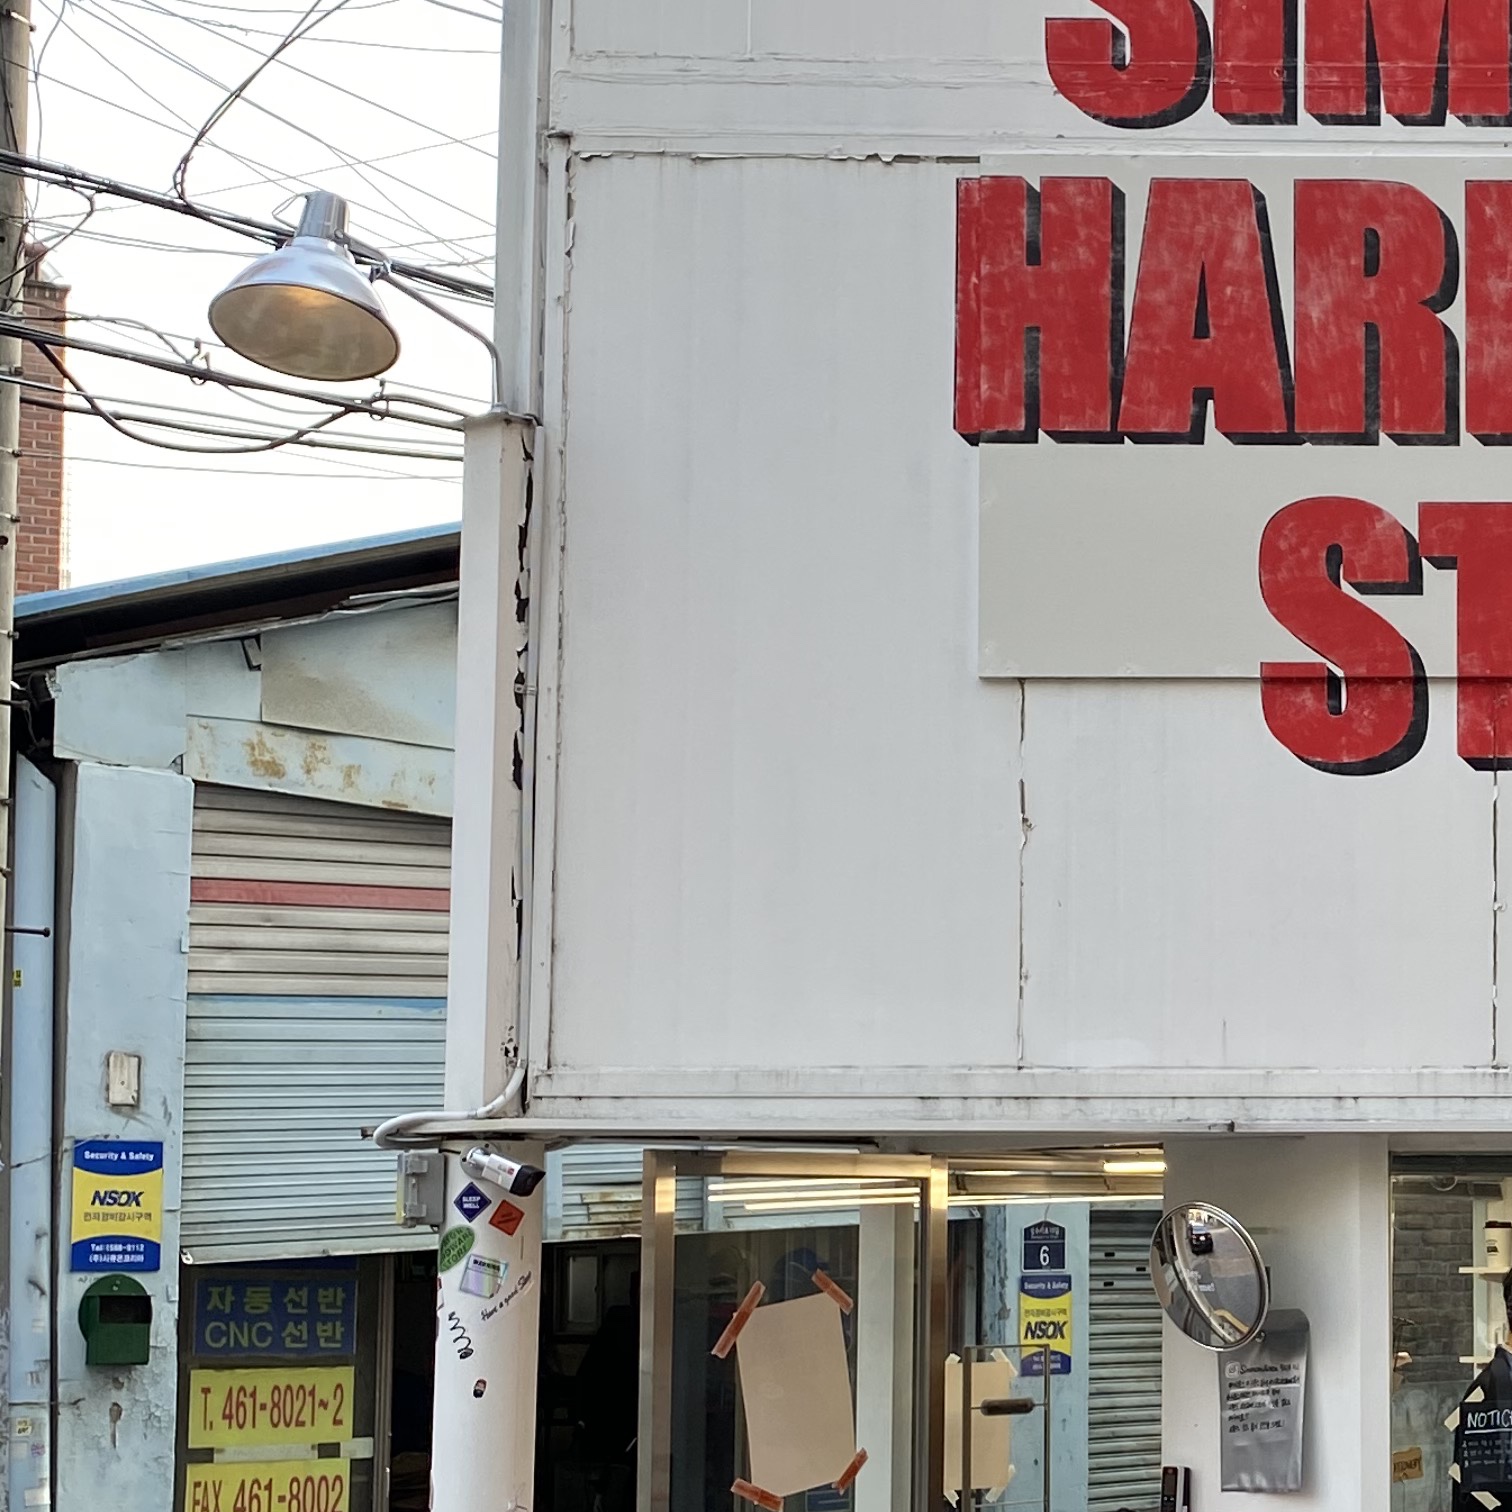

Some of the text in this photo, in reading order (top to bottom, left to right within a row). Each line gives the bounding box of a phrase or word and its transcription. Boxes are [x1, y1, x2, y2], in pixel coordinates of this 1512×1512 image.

[84, 1151, 118, 1161] Security
[129, 1151, 154, 1161] Safety
[91, 1190, 145, 1207] NSOK
[1040, 1245, 1050, 1265] 6
[205, 1320, 345, 1349] CNC 선반
[1024, 1320, 1068, 1340] NSOK
